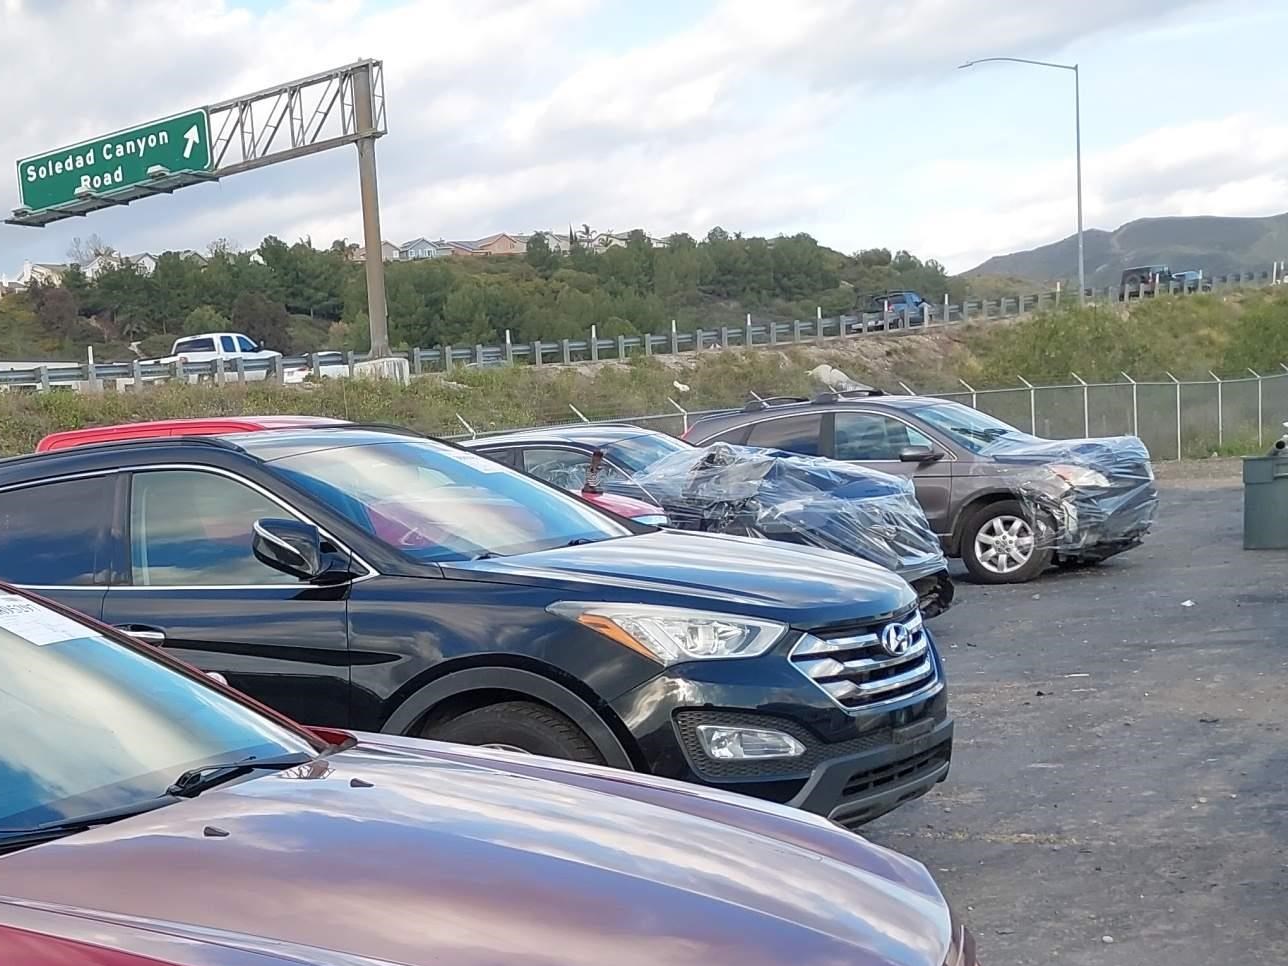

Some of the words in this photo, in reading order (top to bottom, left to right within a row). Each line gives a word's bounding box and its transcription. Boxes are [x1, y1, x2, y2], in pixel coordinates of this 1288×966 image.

[26, 149, 95, 182] Soledad
[102, 130, 169, 160] Canyon
[80, 165, 123, 188] Road
